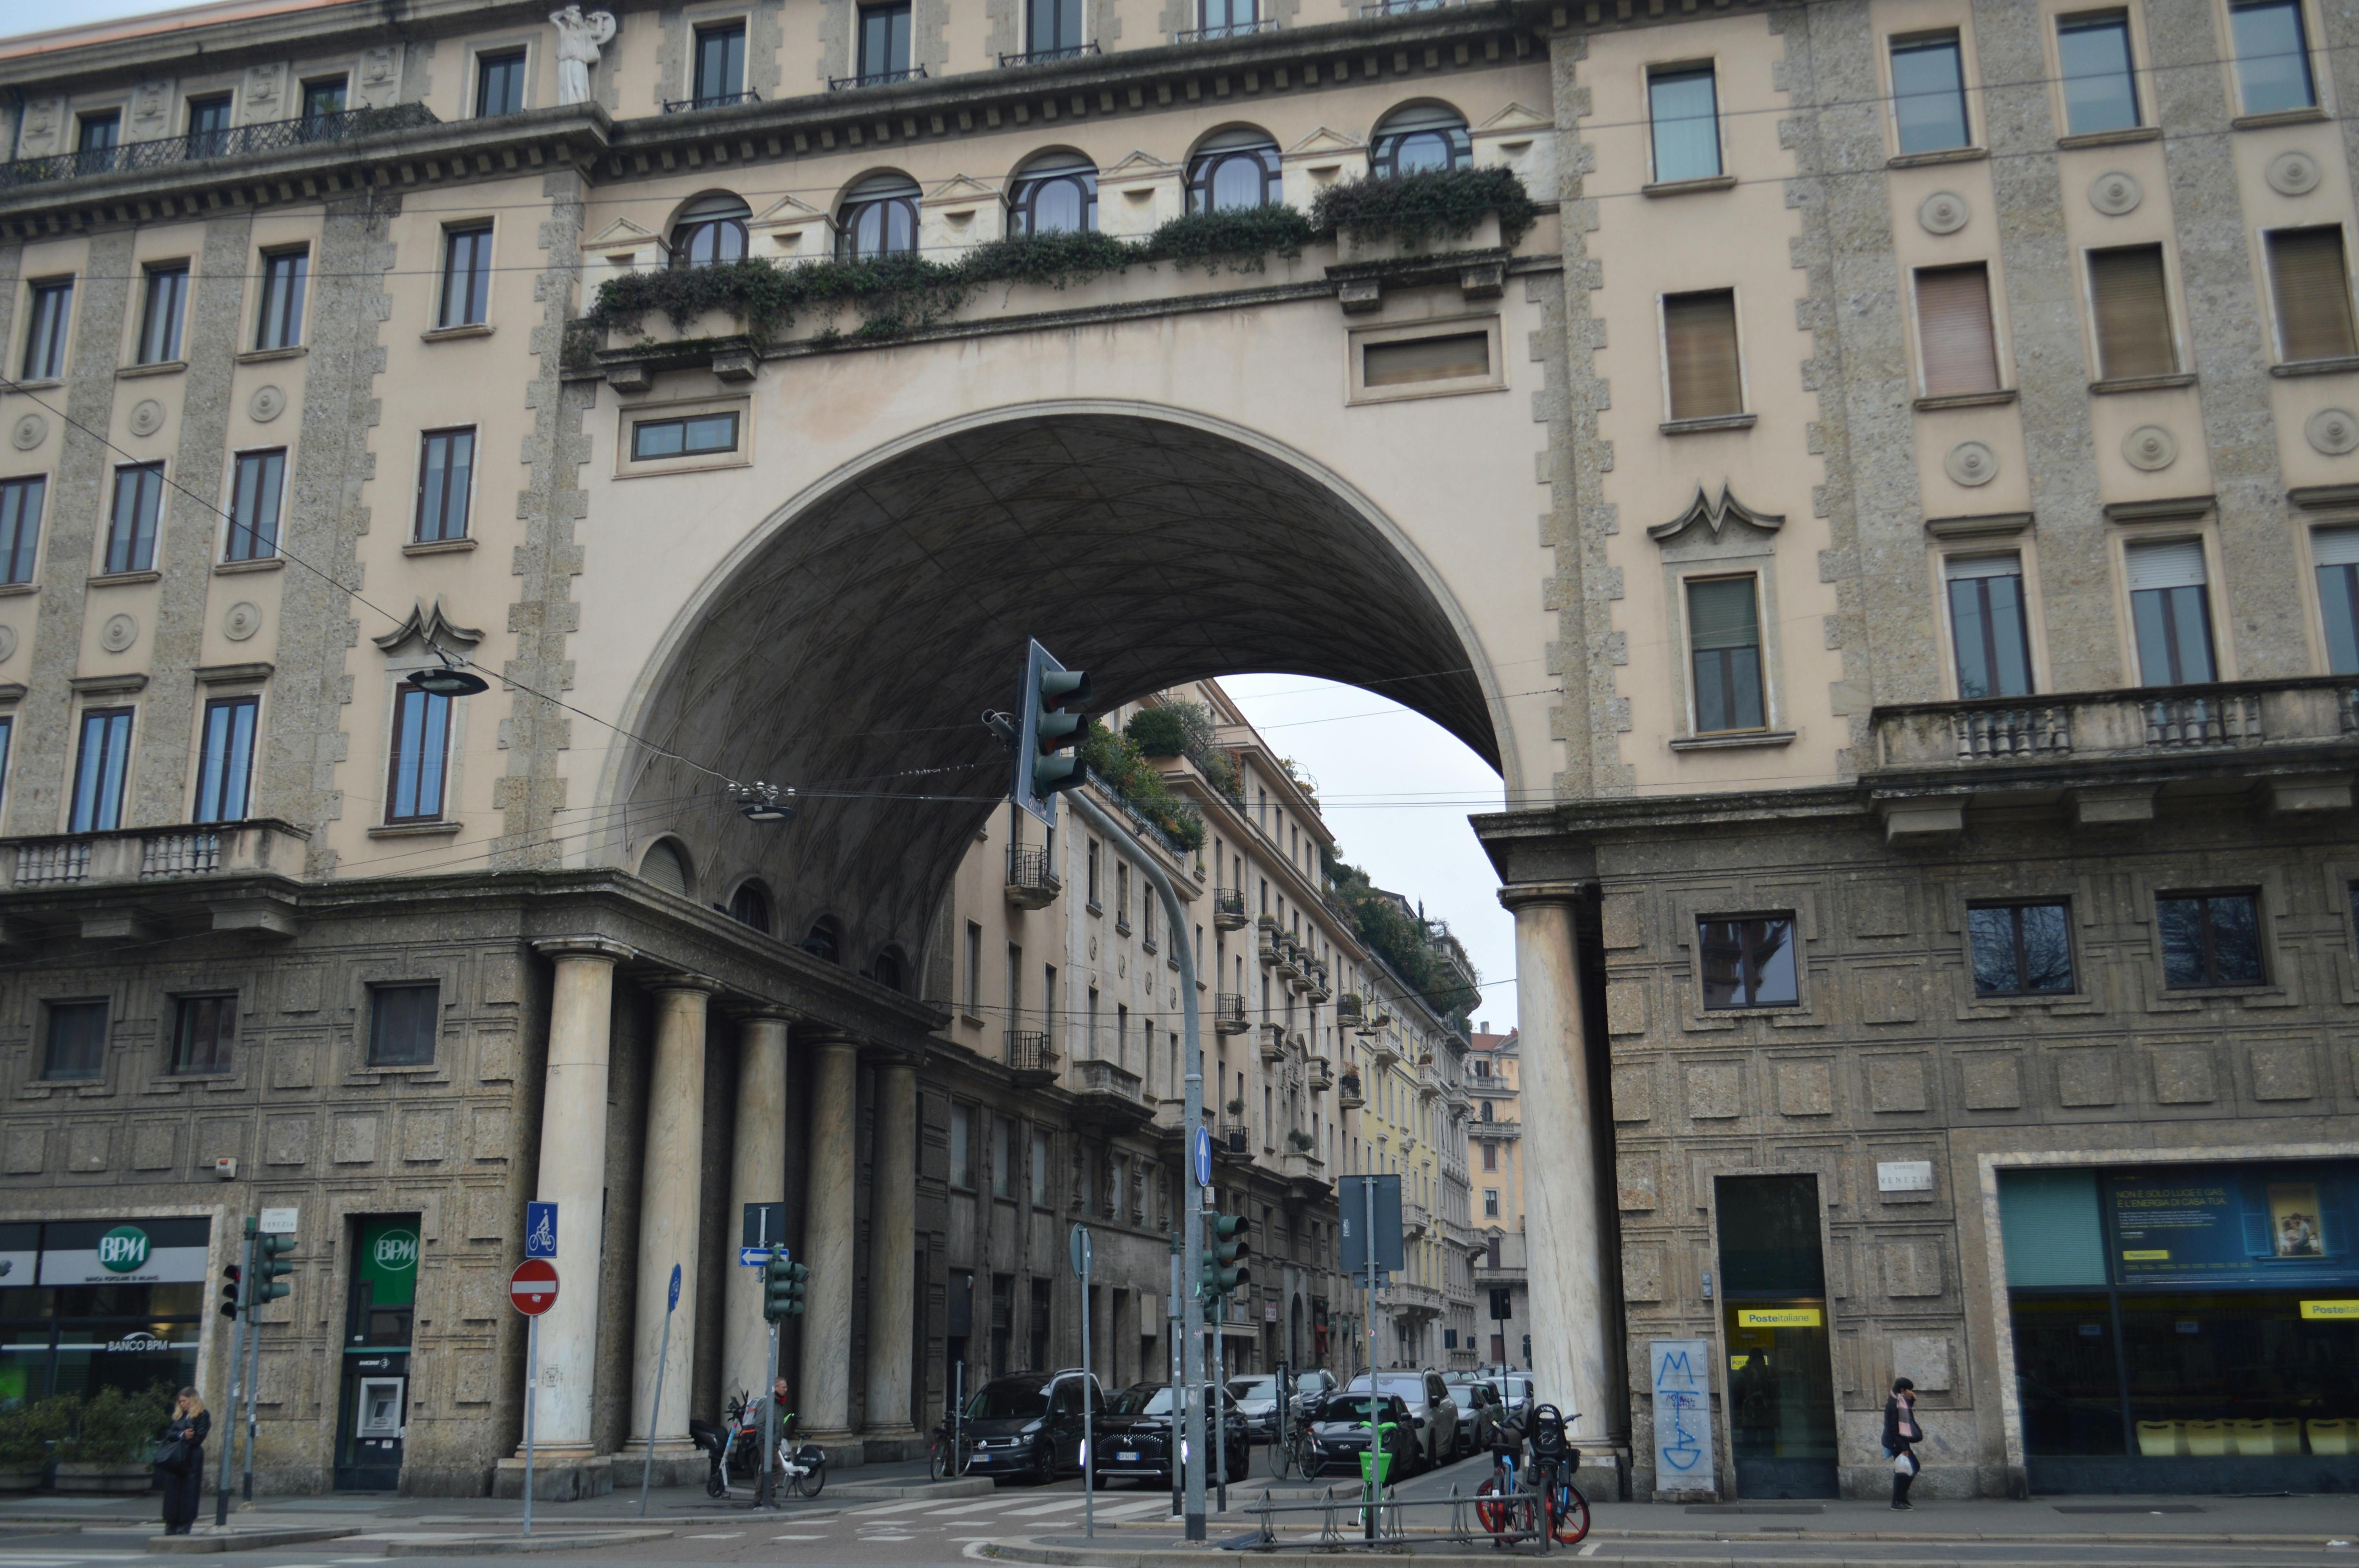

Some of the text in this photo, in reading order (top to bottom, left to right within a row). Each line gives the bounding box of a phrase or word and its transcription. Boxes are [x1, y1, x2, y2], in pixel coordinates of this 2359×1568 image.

[2125, 1199, 2169, 1207] L'ENERGIA
[100, 1236, 146, 1262] BPM
[378, 1239, 416, 1260] BPM
[108, 1340, 168, 1352] BANCO BPM
